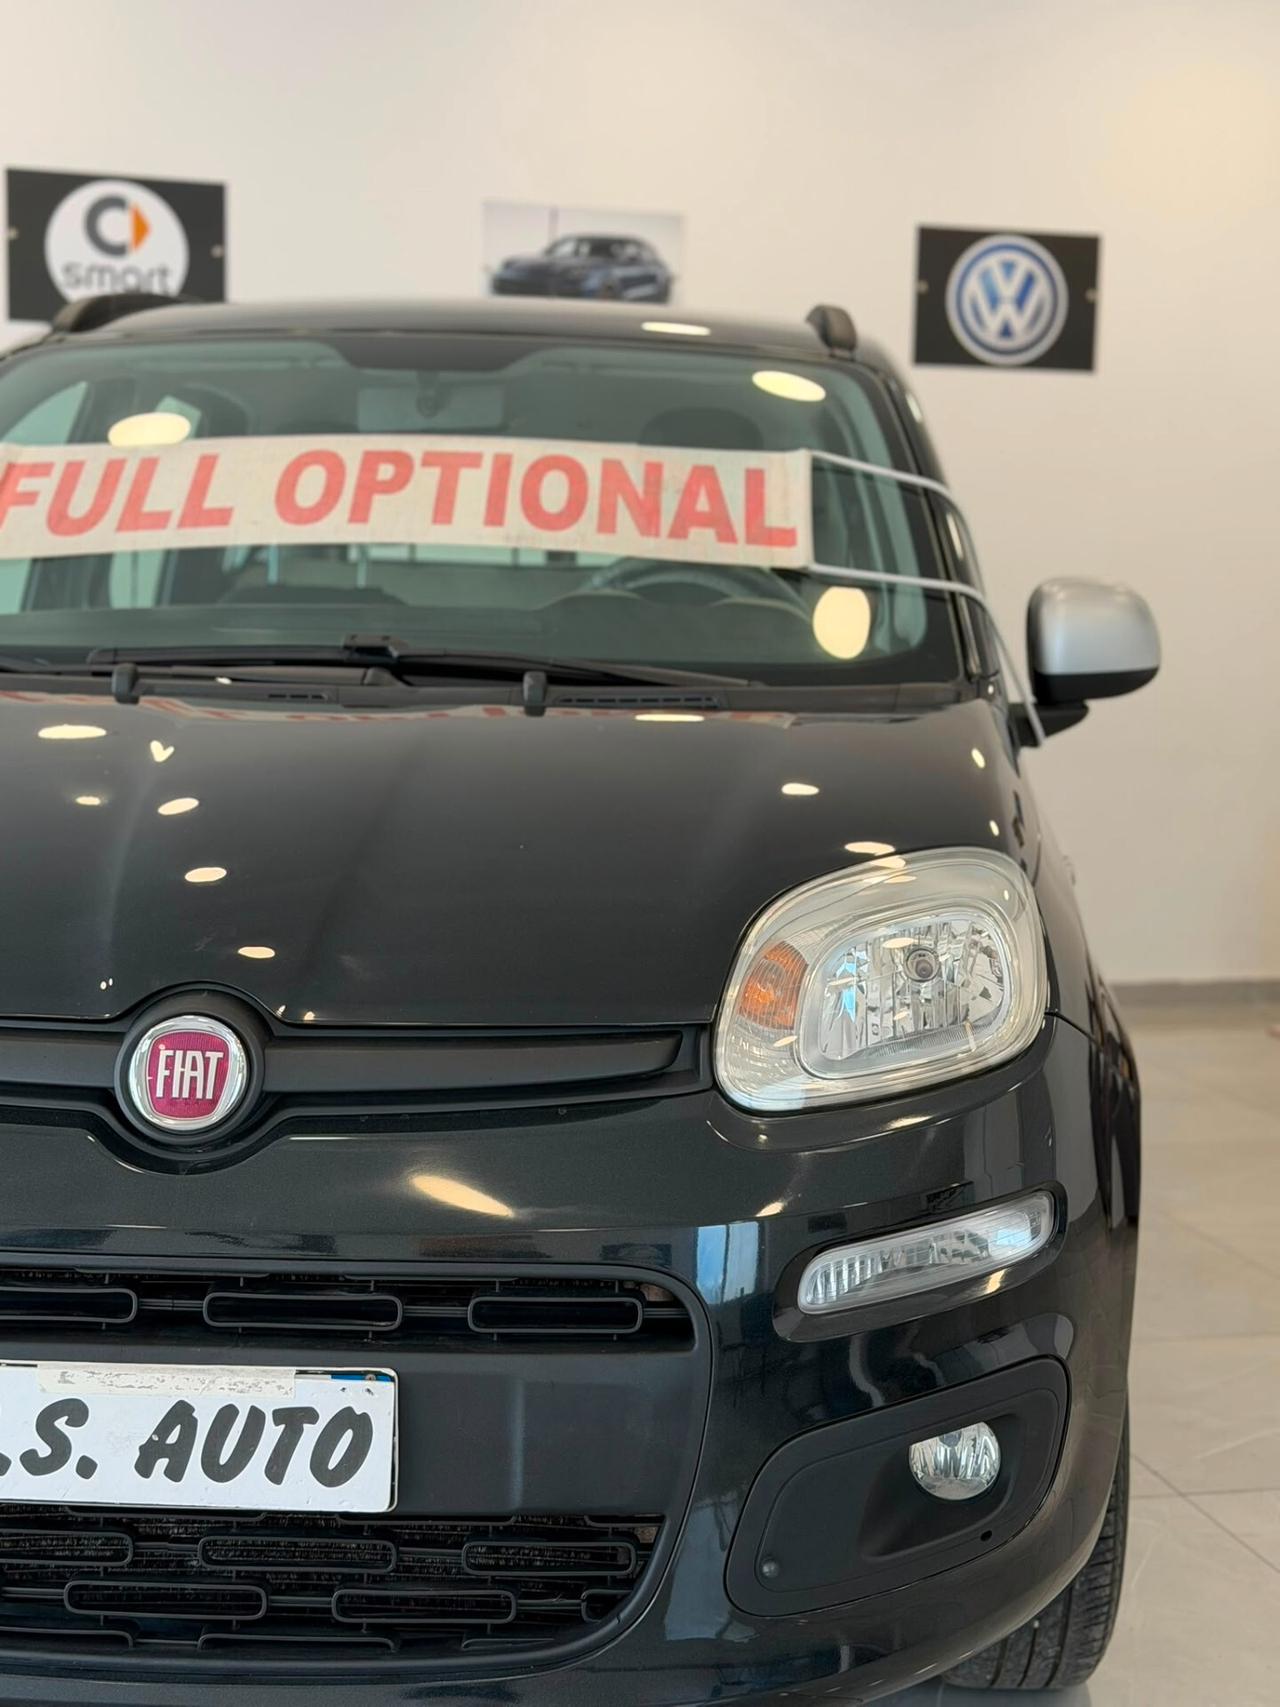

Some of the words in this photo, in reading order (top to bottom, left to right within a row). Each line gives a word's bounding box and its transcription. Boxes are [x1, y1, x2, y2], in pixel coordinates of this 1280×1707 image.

[61, 261, 173, 295] smart
[0, 453, 235, 537] FULL
[274, 449, 798, 549] OPTIONAL
[156, 1049, 225, 1100] FIAT
[134, 1399, 374, 1488] AUTO
